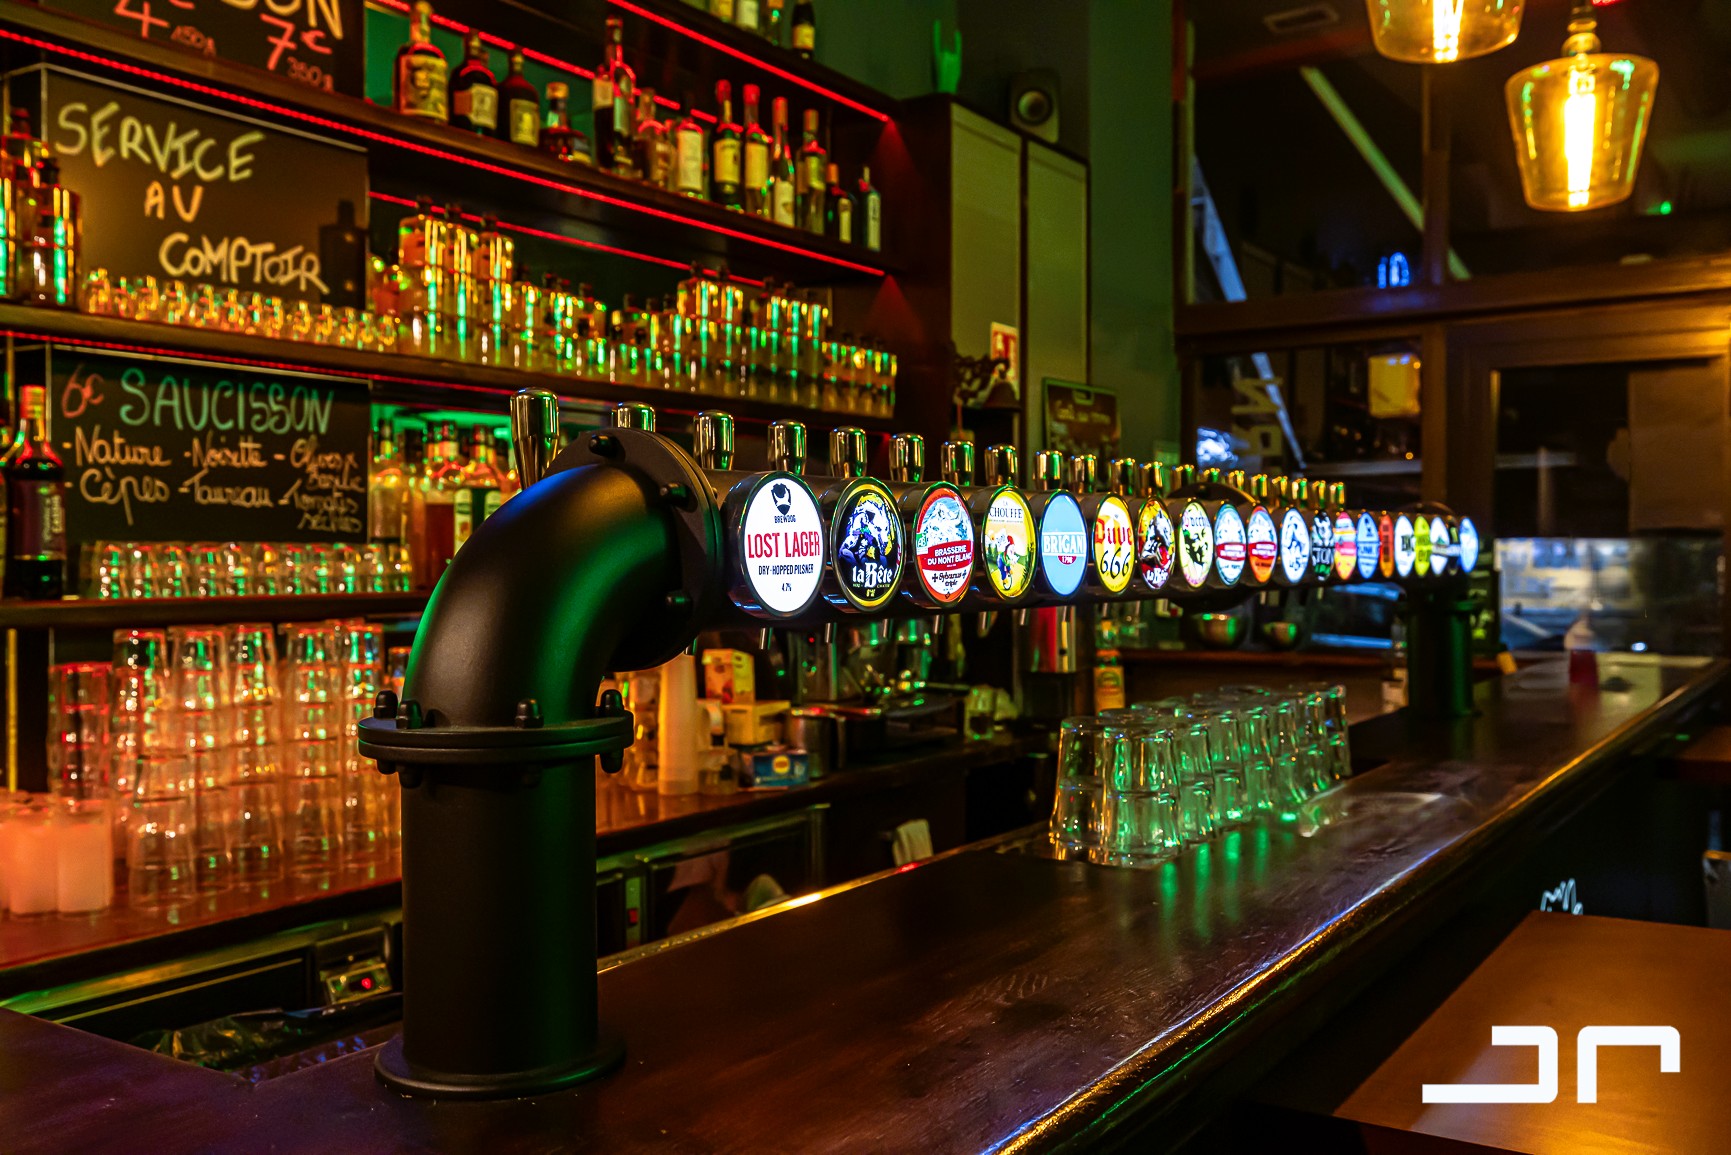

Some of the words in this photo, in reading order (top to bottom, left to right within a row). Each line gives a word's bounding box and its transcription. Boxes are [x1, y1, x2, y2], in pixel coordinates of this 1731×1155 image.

[55, 102, 266, 182] SERVICE
[144, 180, 204, 223] AU
[159, 232, 331, 295] COMPTOIR
[119, 367, 335, 434] SAUCISSON
[774, 515, 796, 523] BREWDOG
[989, 507, 1023, 519] CHOUFFE
[747, 532, 781, 559] LOST
[784, 530, 820, 558] LAGER
[1043, 535, 1085, 554] BRIGAN
[1095, 518, 1133, 546] Duve
[927, 558, 937, 566] DU
[938, 555, 955, 565] MONT
[955, 551, 972, 562] BLANC
[934, 544, 967, 557] BRASSERIE
[1099, 547, 1131, 580] 666
[758, 564, 794, 576] DRY-HOPPED
[794, 563, 814, 574] PILSNER
